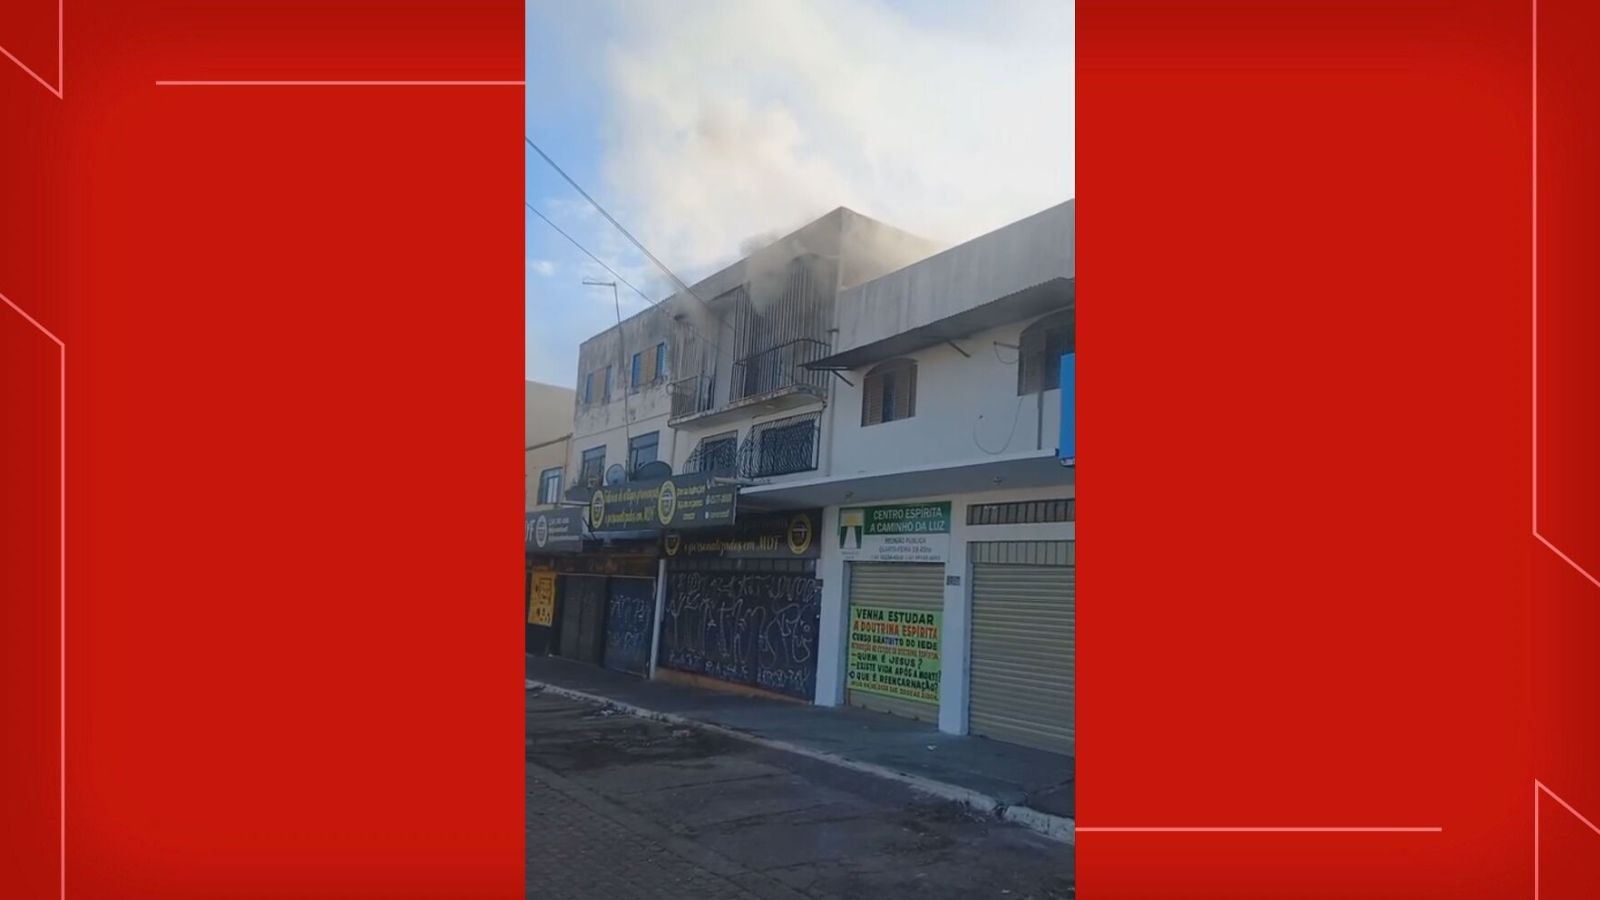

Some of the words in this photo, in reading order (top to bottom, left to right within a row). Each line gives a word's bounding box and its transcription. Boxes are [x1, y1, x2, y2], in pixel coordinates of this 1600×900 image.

[873, 509, 904, 520] CENTRO
[905, 506, 943, 519] ESPÍRITA
[870, 524, 876, 533] A
[876, 522, 914, 533] CAMINHO
[915, 521, 926, 532] DA
[928, 520, 945, 531] LUZ
[856, 608, 884, 621] VENHA
[888, 610, 934, 625] ESTUDAR
[853, 621, 859, 631] A
[860, 621, 900, 636] DOUTRINA
[902, 624, 938, 639] ESPÍRITA
[852, 632, 871, 643] CURSO
[873, 635, 904, 646] GRATUITO
[906, 639, 915, 648] DO
[881, 653, 886, 663] É
[889, 656, 916, 667] JESUS
[856, 672, 870, 681] QUE
[878, 664, 893, 674] VIDA
[894, 666, 912, 677] APÓS
[913, 670, 917, 678] A
